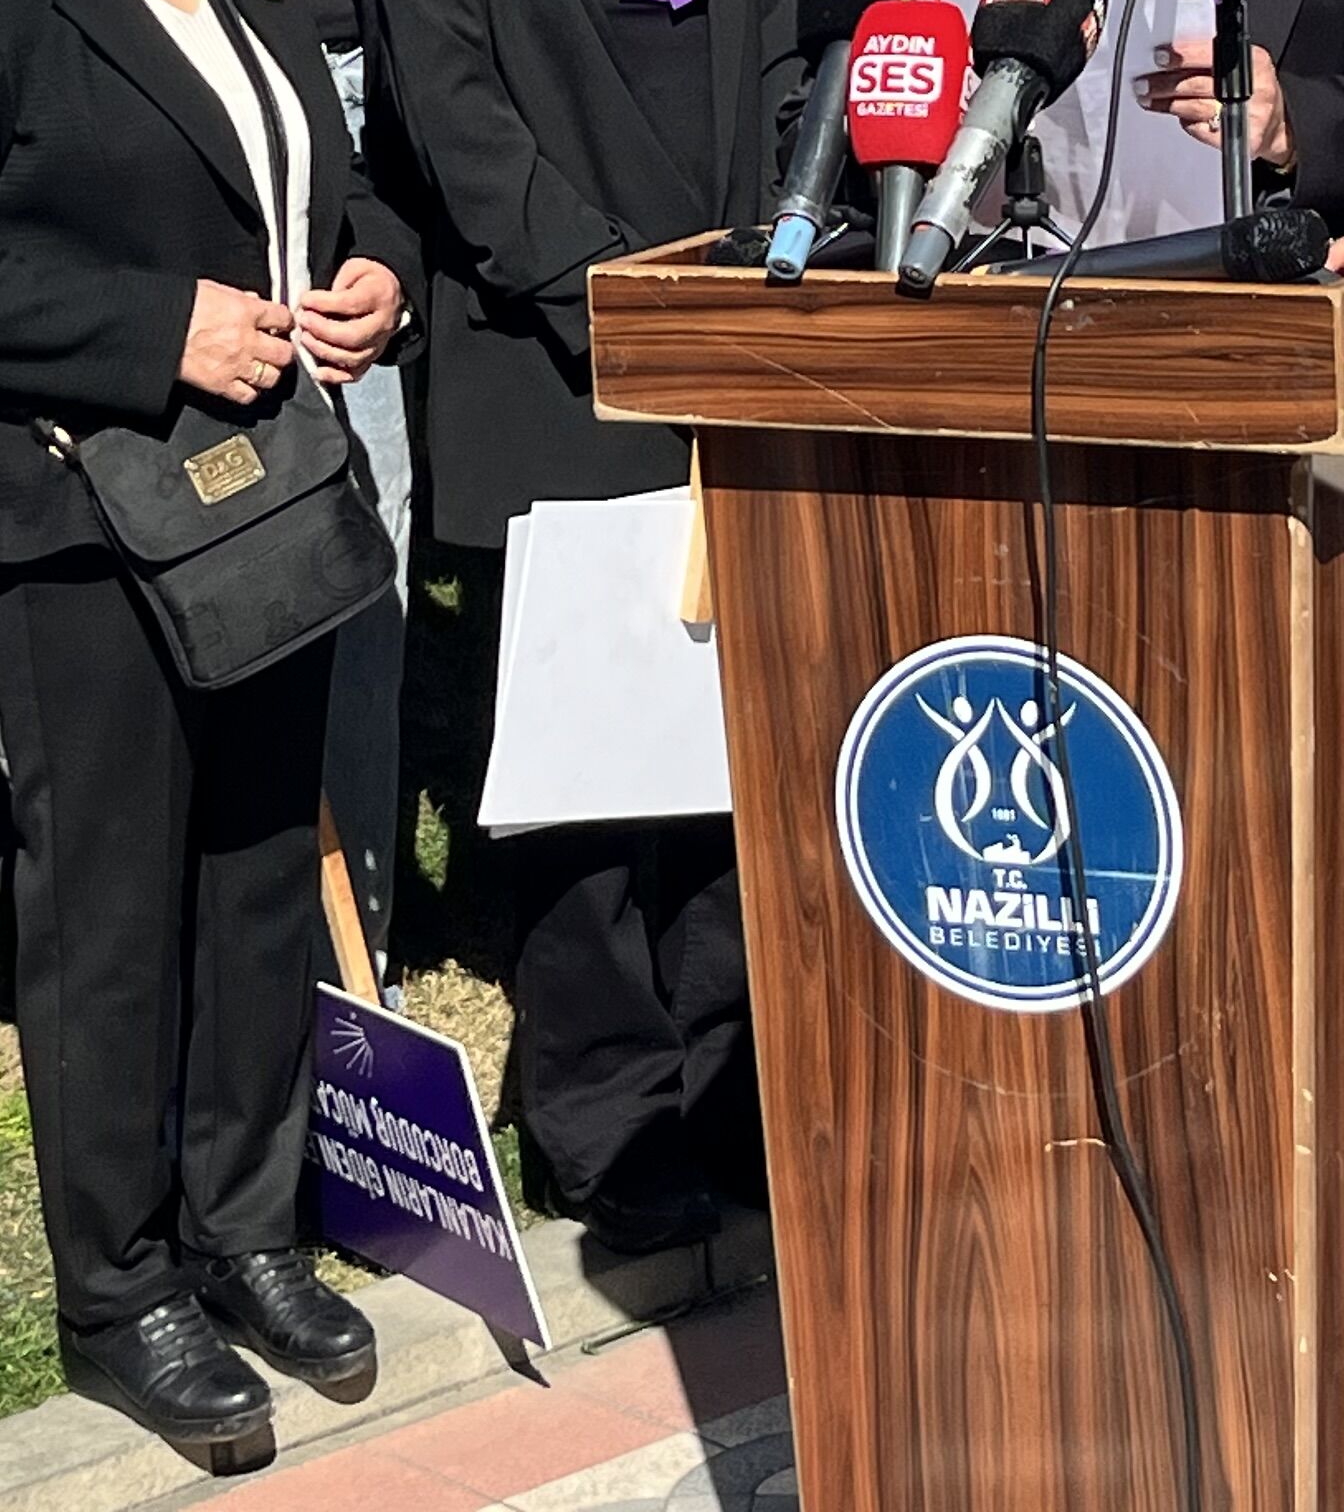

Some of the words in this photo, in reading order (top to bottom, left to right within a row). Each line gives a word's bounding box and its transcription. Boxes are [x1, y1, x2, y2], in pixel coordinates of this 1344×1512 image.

[863, 34, 936, 56] AYDIN
[856, 62, 935, 94] SES
[313, 1079, 374, 1140] MÜCA
[304, 1131, 385, 1200] GİDENLE
[382, 1164, 513, 1261] KALANLARIN
